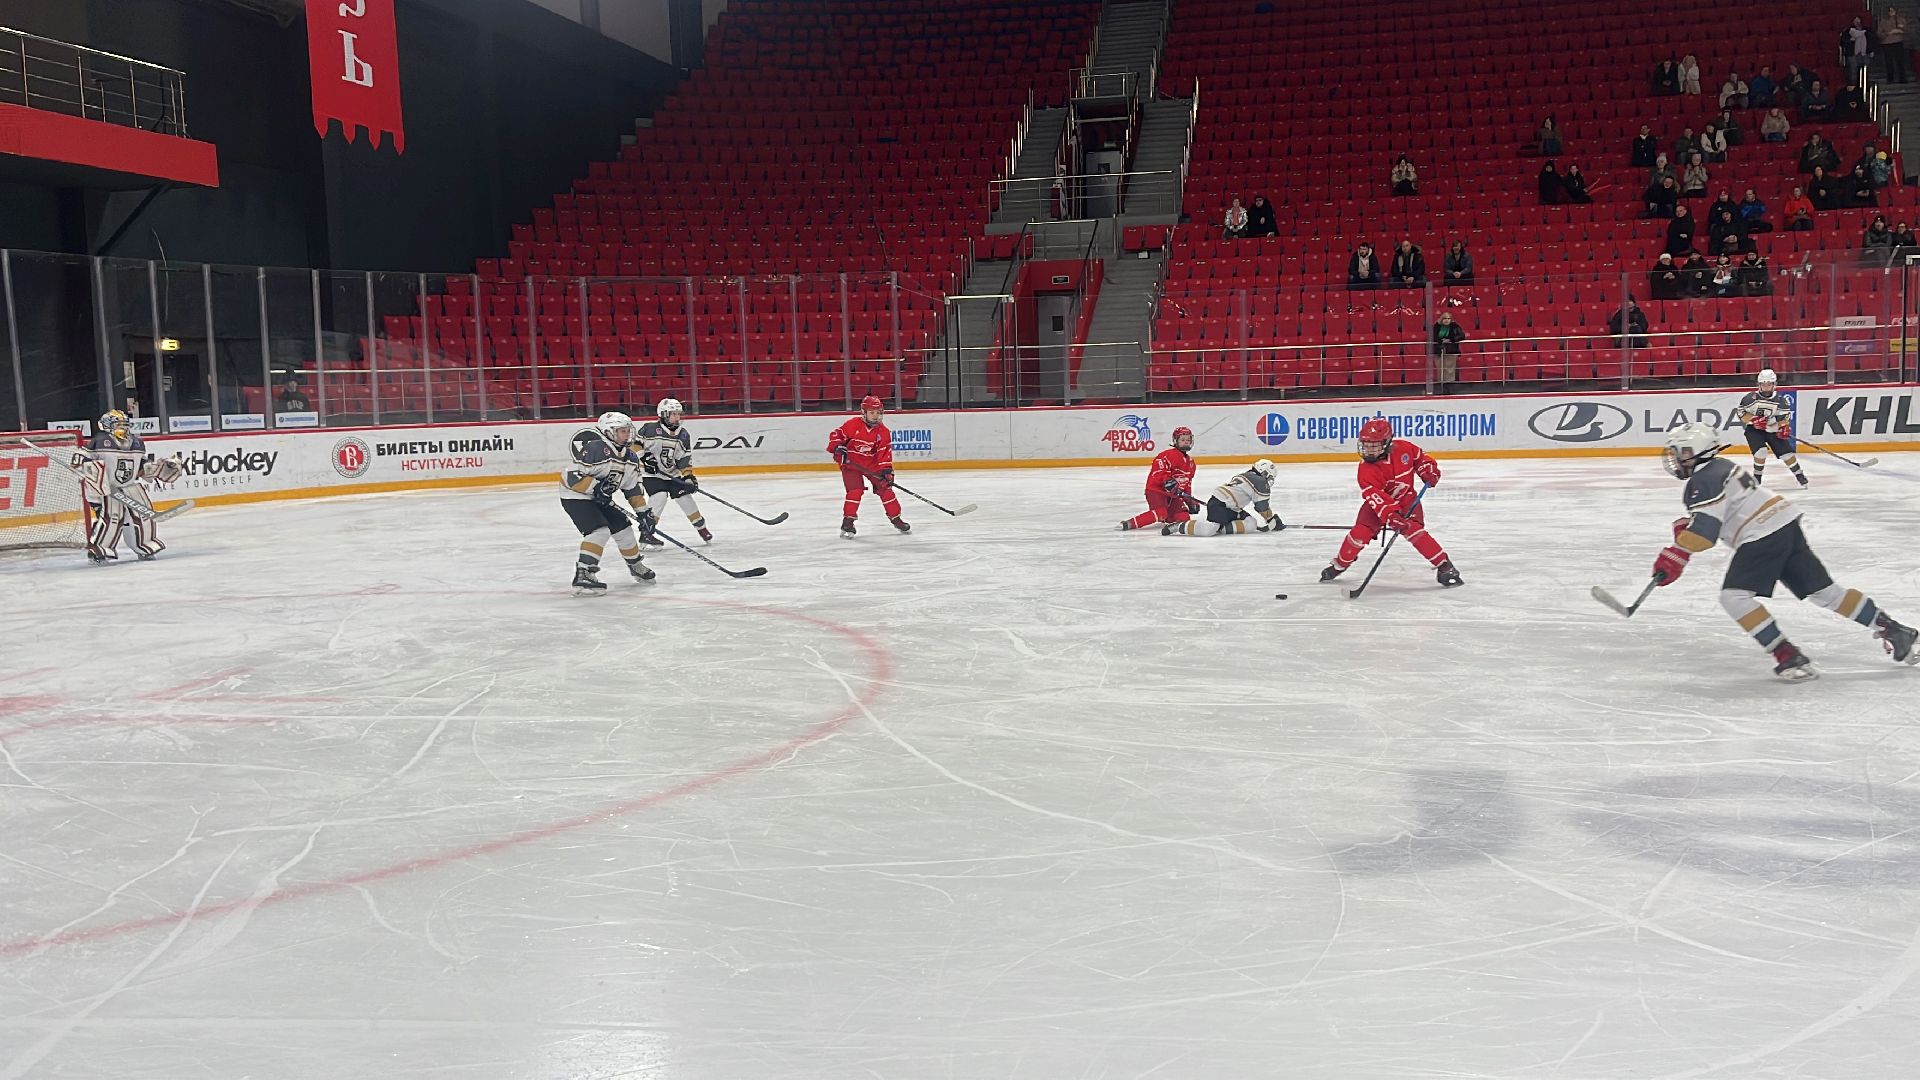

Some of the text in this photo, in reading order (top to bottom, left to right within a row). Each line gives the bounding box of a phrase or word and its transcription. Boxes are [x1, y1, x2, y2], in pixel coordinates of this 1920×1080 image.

[1811, 396, 1920, 435] KHL
[1297, 411, 1496, 444] севернтегазпром
[891, 430, 932, 443] АЗПРОМ
[1101, 430, 1137, 441] АВТО
[376, 435, 514, 456] БИЛЕТЫ ОНЛАЙН
[693, 436, 764, 450] DAI
[1112, 440, 1155, 452] РАДИО
[401, 457, 483, 471] HCVITYAZ.RU
[185, 475, 252, 489] YOURSELF
